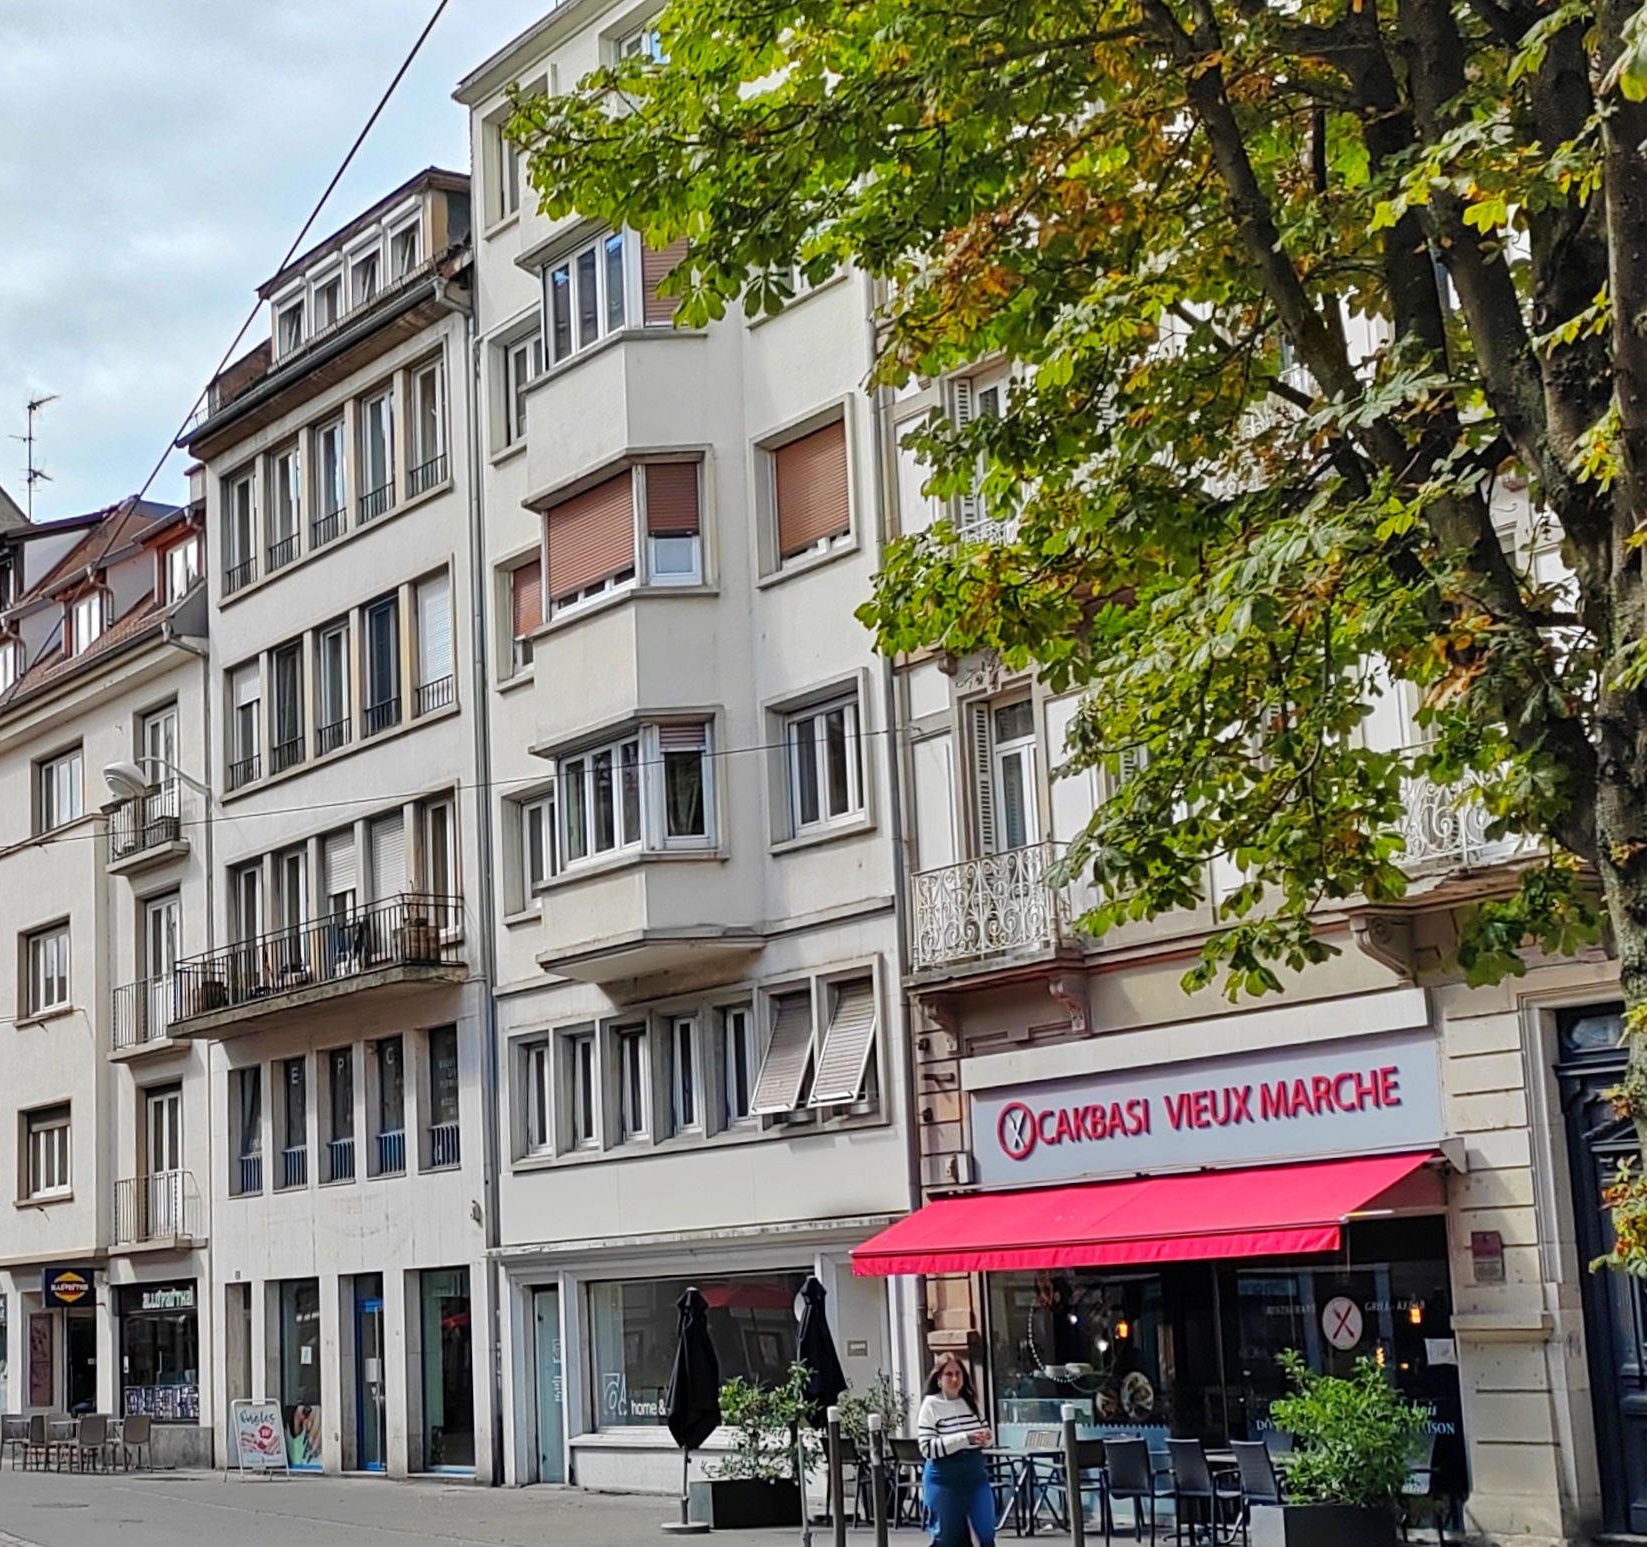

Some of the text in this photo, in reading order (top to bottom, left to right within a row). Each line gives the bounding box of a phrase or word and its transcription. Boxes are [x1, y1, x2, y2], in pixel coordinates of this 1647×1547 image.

[1164, 1084, 1254, 1130] VIEUX
[1260, 1066, 1402, 1120] MARCHE
[631, 1398, 666, 1416] home &
